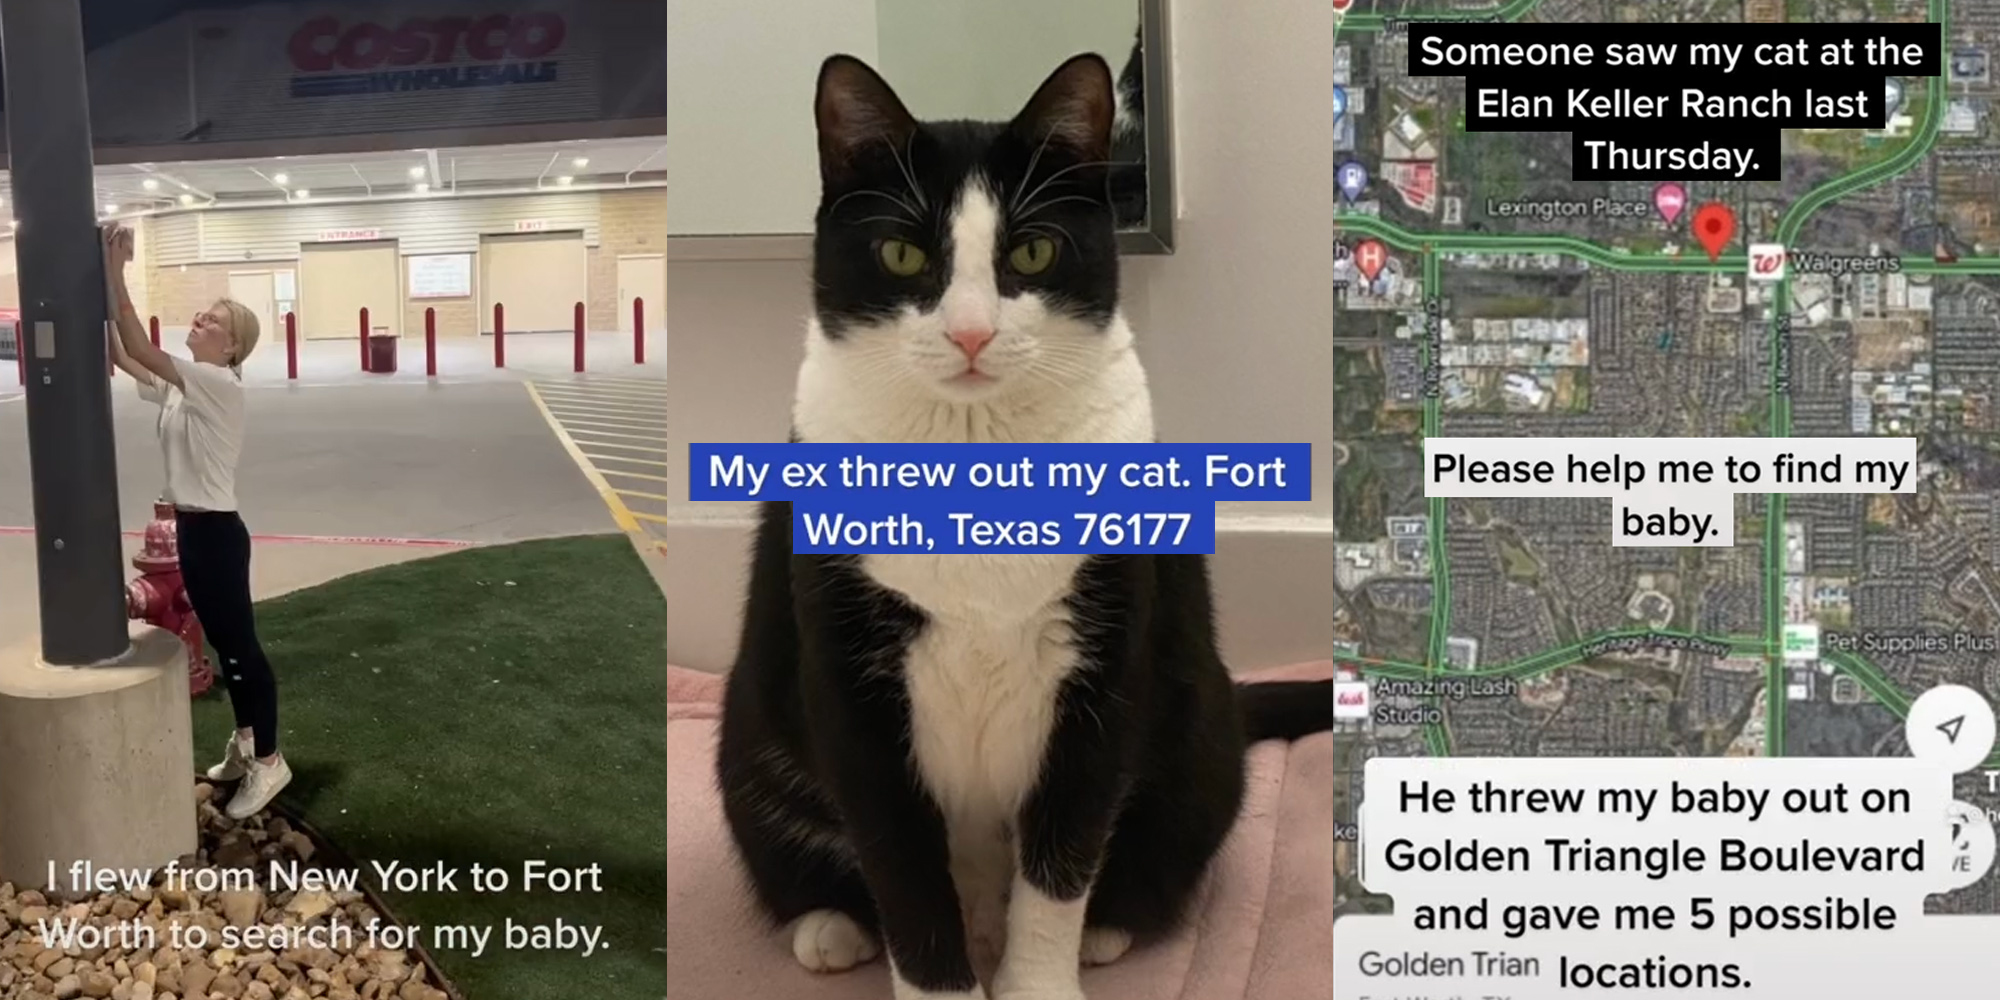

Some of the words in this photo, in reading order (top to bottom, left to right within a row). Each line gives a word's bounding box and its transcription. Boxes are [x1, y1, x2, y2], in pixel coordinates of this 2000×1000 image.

[287, 12, 566, 72] COSTCO
[1487, 199, 1587, 221] Lexington
[1592, 198, 1647, 216] Place
[320, 229, 377, 240] ENTRANCE
[517, 220, 543, 230] EXIT
[1794, 254, 1900, 275] Walgreens
[1826, 633, 1857, 650] Pet
[1864, 633, 1948, 654] Supplies
[1955, 633, 1994, 651] Plus
[1377, 679, 1465, 698] Amazing
[1471, 678, 1517, 695] Lash
[1377, 705, 1441, 723] Studio
[1359, 951, 1464, 976] Golden
[1471, 951, 1539, 976] Trian
